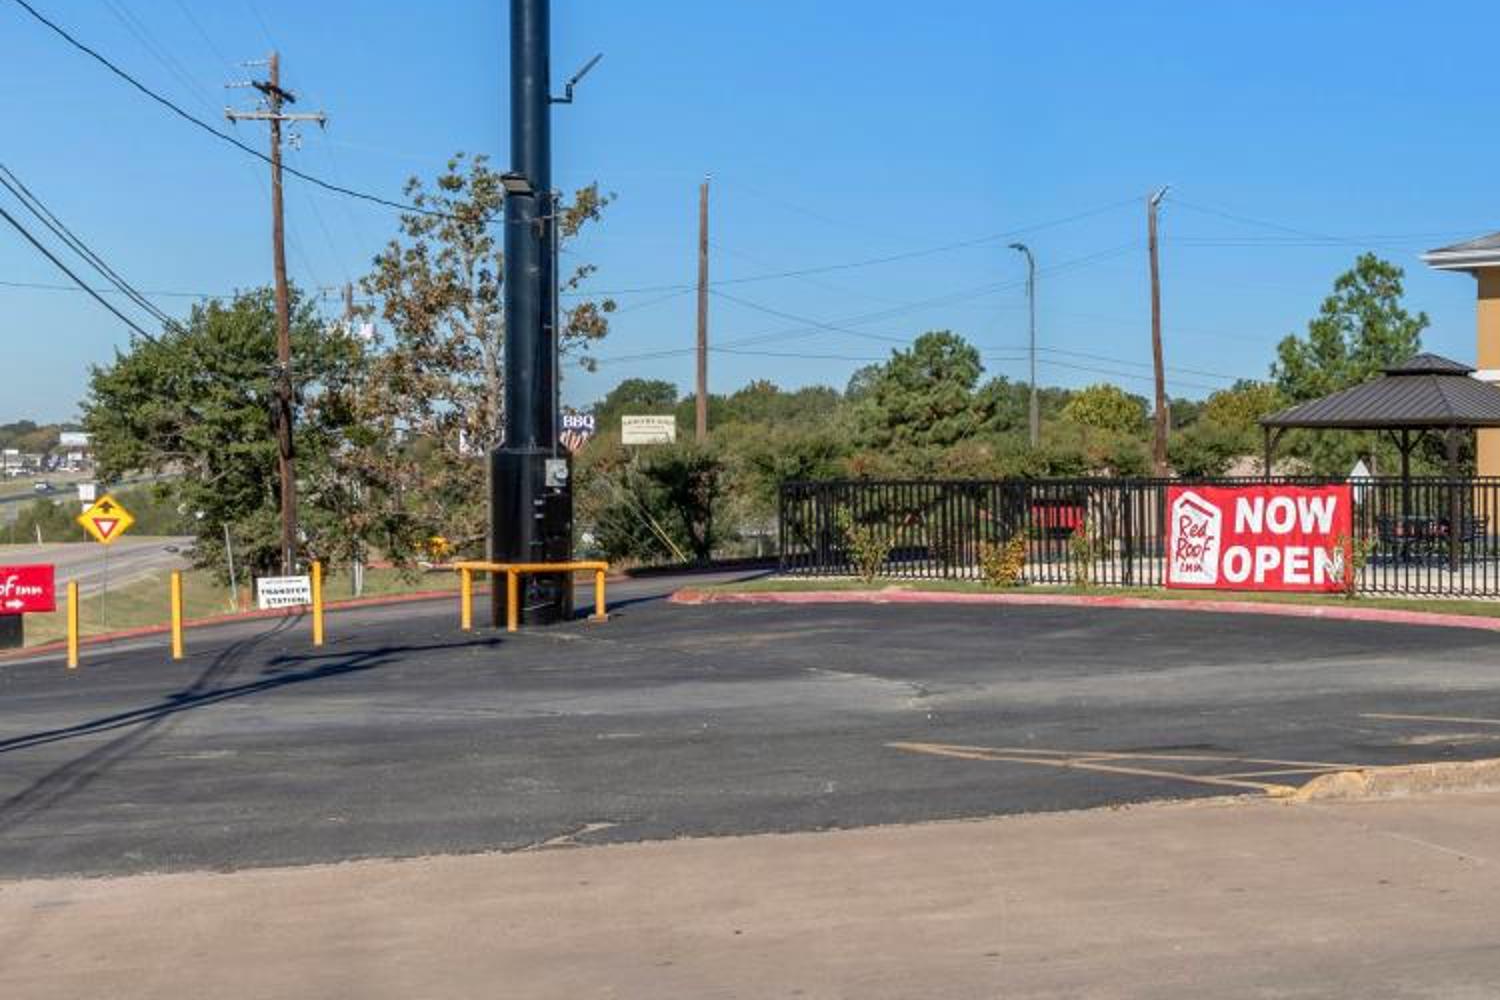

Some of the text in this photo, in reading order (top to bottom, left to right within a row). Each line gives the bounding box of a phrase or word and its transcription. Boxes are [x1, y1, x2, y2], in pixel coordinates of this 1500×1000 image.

[563, 415, 595, 429] BBQ
[1179, 515, 1209, 538] Red
[1234, 496, 1337, 534] NOW
[1175, 536, 1215, 563] Roof
[1222, 545, 1345, 585] OPEN
